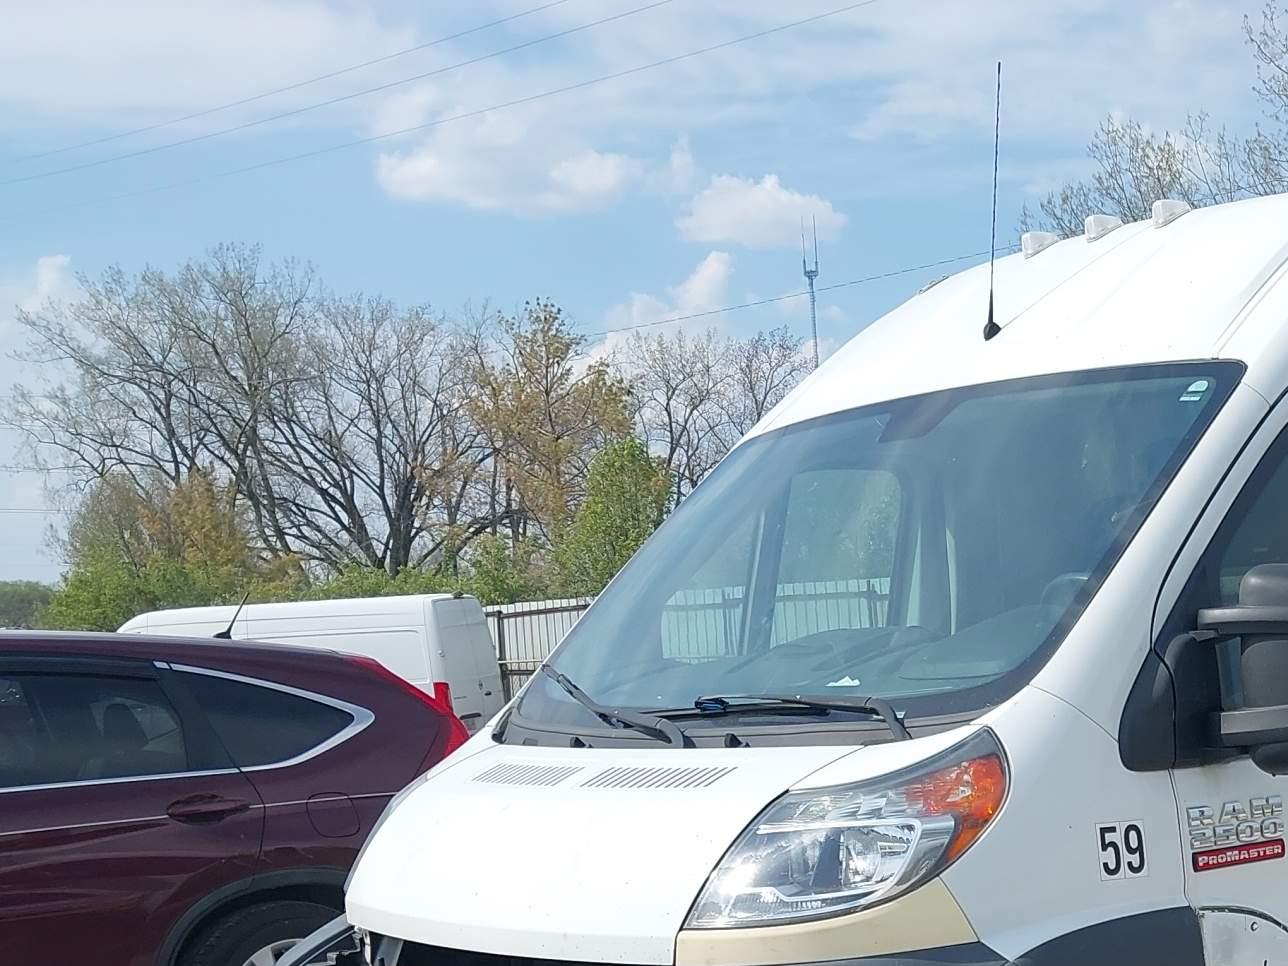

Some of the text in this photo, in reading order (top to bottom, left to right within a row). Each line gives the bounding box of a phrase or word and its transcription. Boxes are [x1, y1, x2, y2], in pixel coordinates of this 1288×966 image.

[1186, 795, 1284, 828] RAM
[1099, 823, 1146, 877] 59
[1189, 818, 1285, 851] 2500
